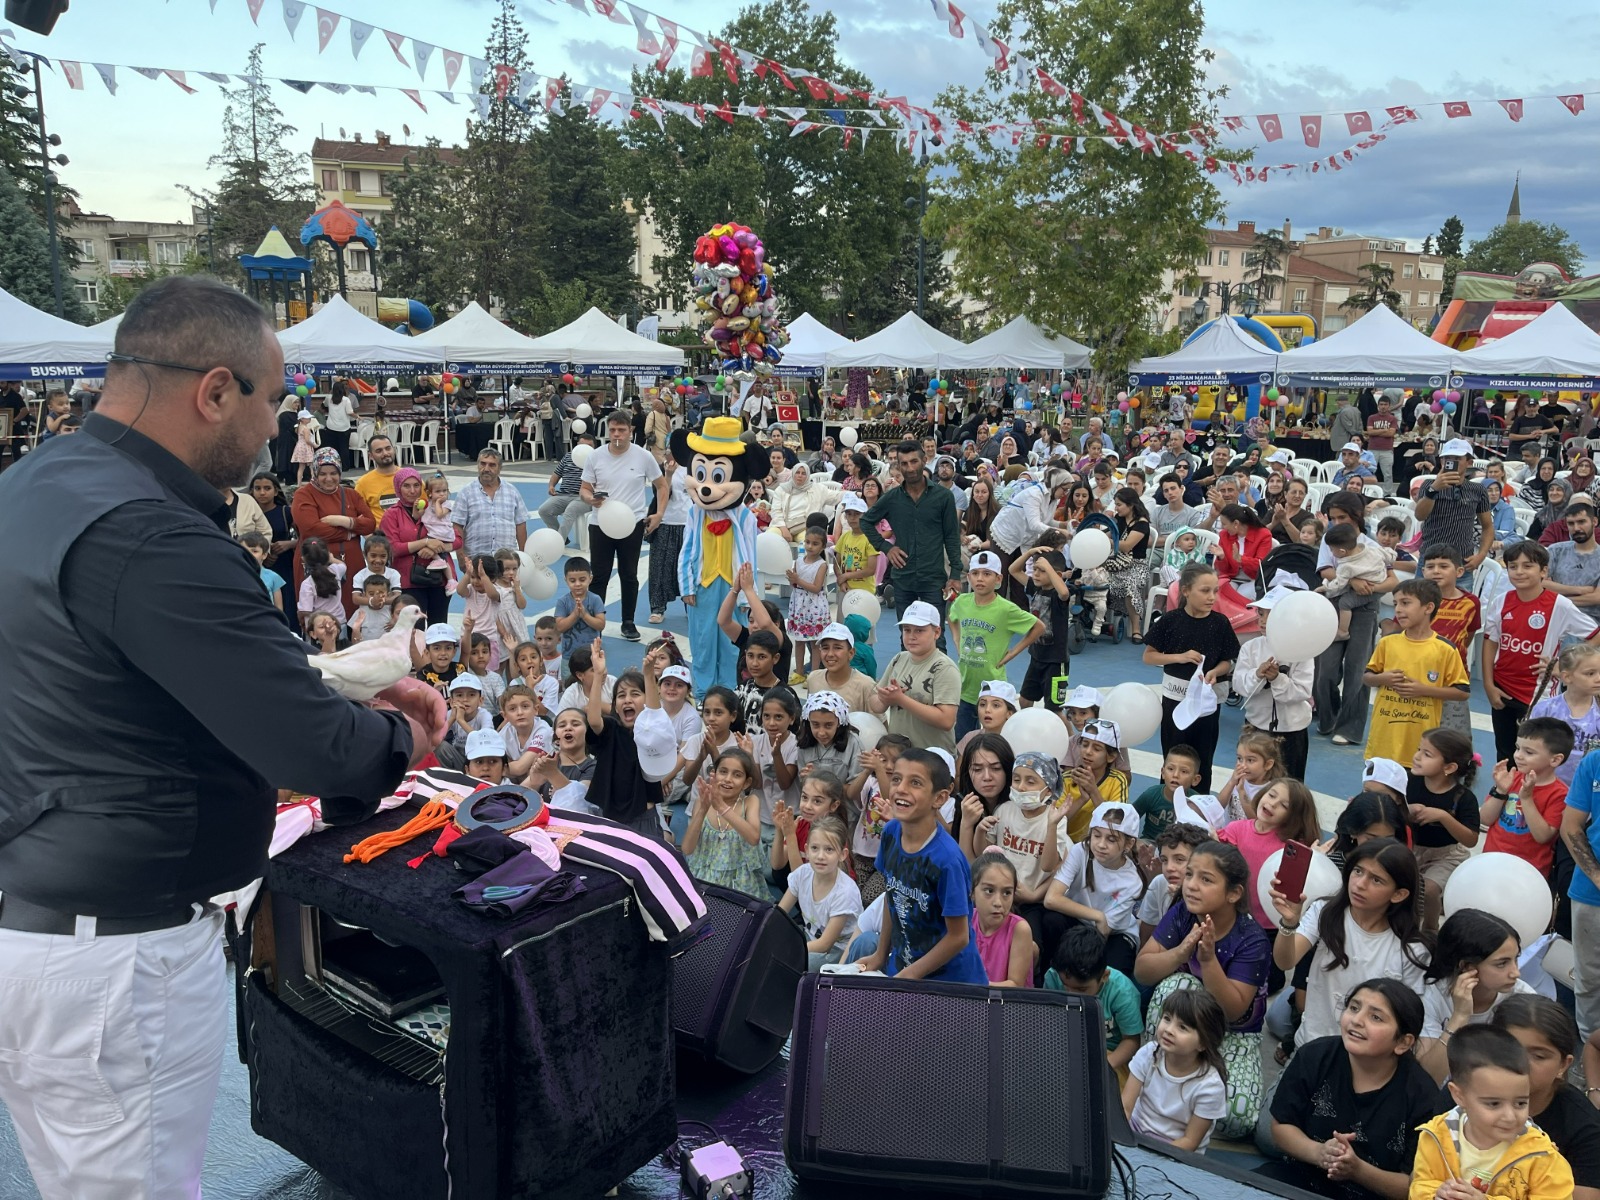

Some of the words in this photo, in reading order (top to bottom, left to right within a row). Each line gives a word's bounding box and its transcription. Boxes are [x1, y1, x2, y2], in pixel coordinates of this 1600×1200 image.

[31, 366, 84, 377] BUSMEK
[1557, 381, 1593, 389] DERNEĞİ
[1167, 682, 1189, 696] SUMME
[1385, 695, 1427, 707] BELEDİYESİ
